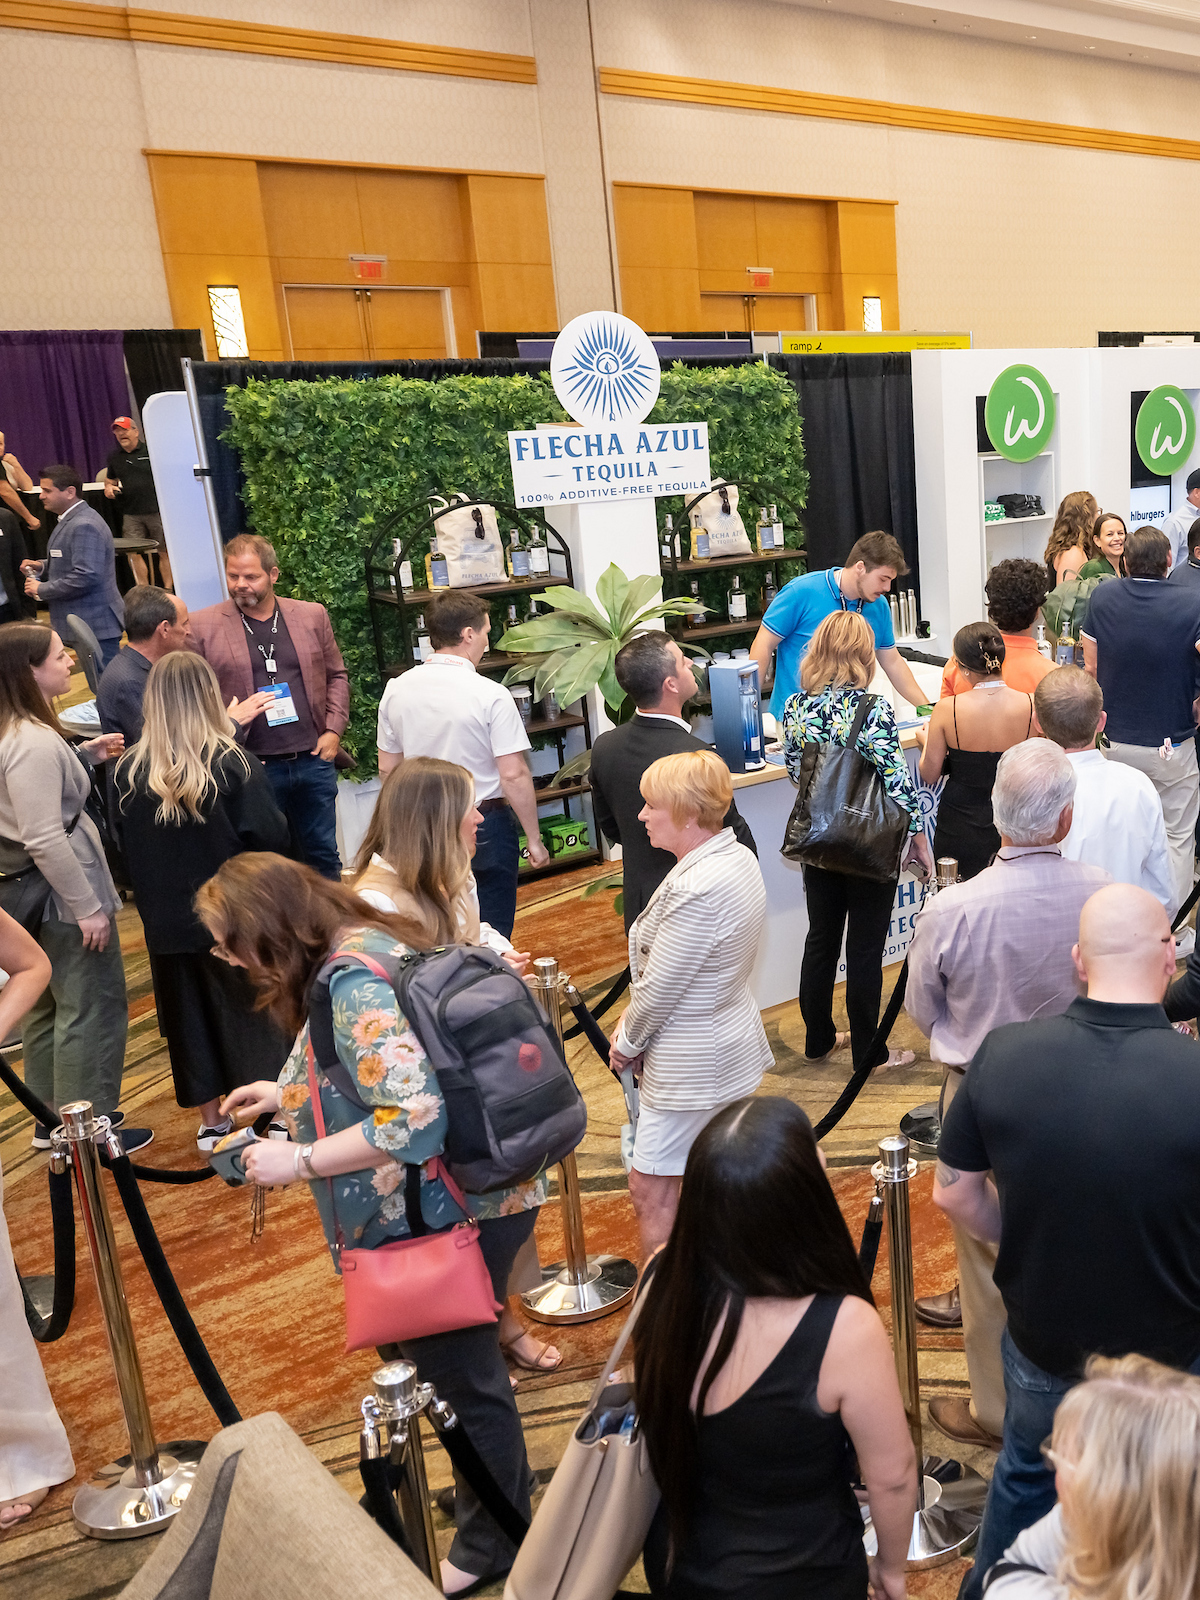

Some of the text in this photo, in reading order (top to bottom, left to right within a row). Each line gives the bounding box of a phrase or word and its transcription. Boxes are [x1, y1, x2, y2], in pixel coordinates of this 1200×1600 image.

[790, 342, 813, 352] ramp
[515, 428, 704, 461] FLECHA AZUL
[572, 461, 658, 482] TEQUILA
[520, 481, 707, 503] 100% ADDITIVE-FREE TEQUILA
[1130, 510, 1165, 521] hlburgers
[709, 532, 730, 540] ECHA
